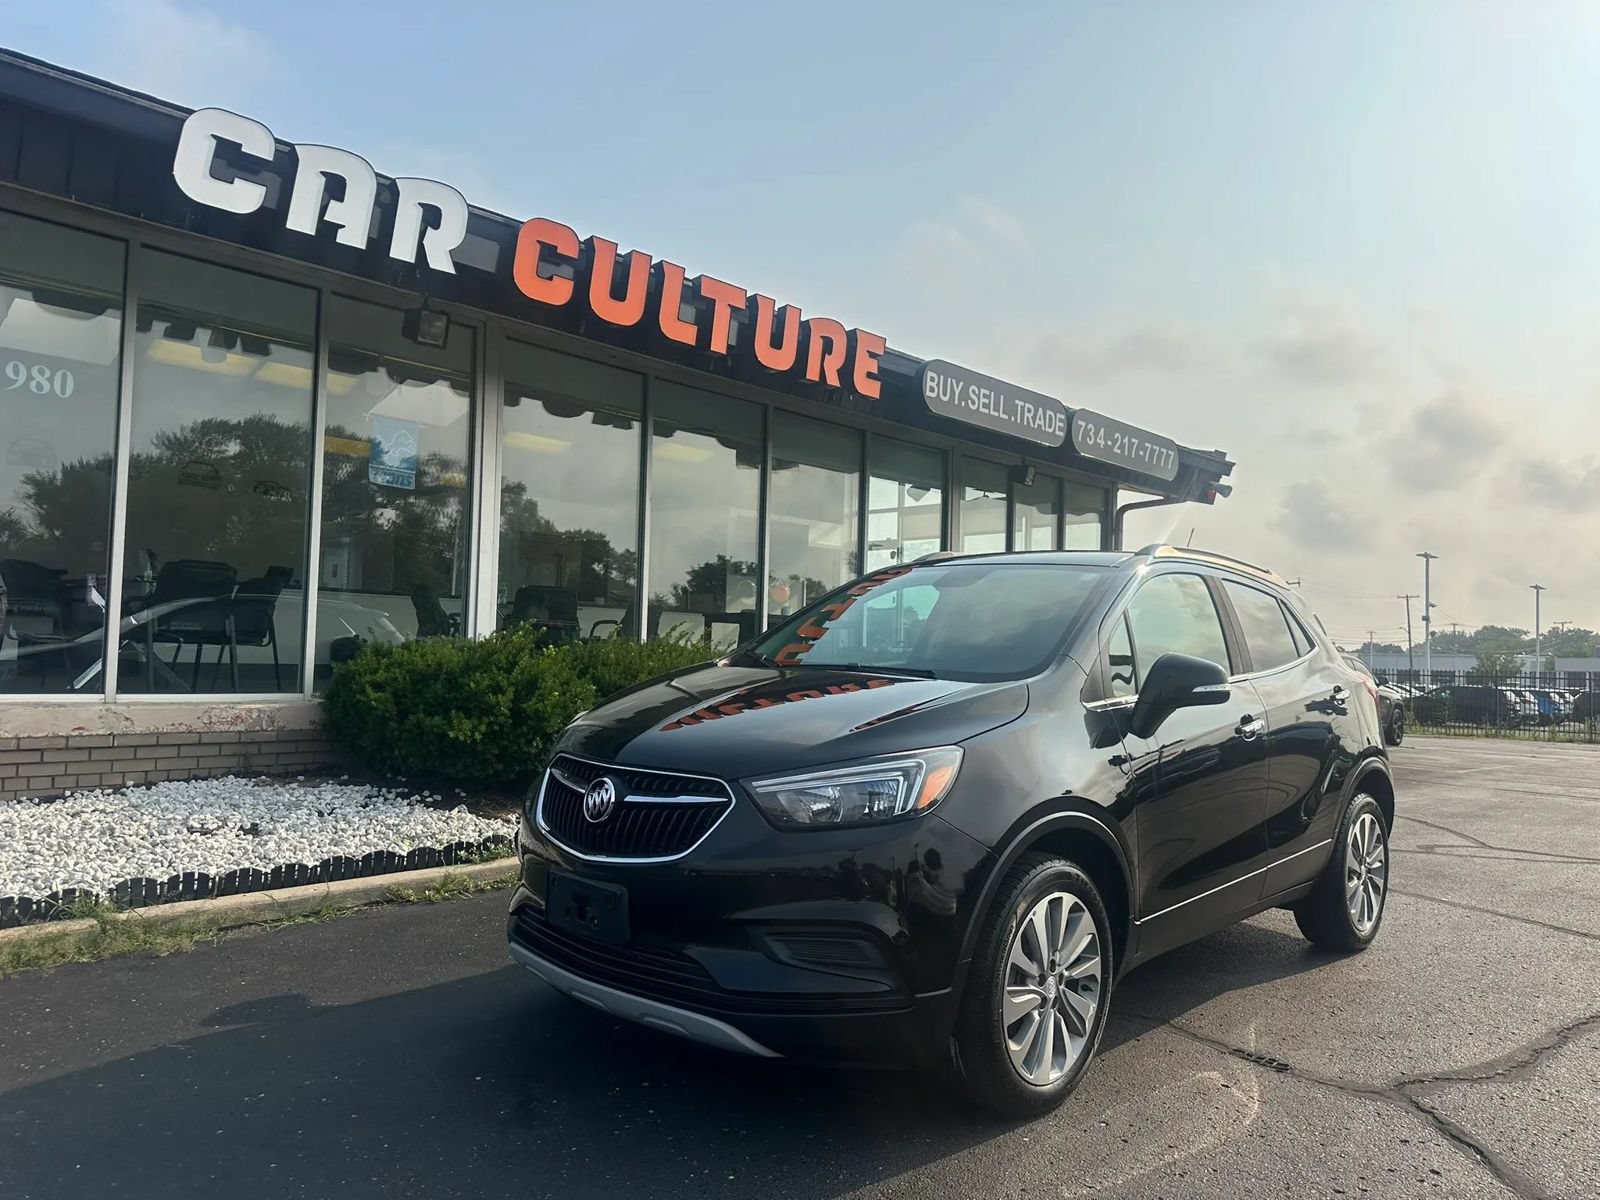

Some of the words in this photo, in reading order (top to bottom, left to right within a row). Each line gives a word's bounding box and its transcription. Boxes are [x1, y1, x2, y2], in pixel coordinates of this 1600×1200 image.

[173, 108, 469, 274] CAR
[513, 217, 887, 399] CULTURE
[4, 360, 74, 398] 980
[1077, 419, 1175, 470] 734-217-7777
